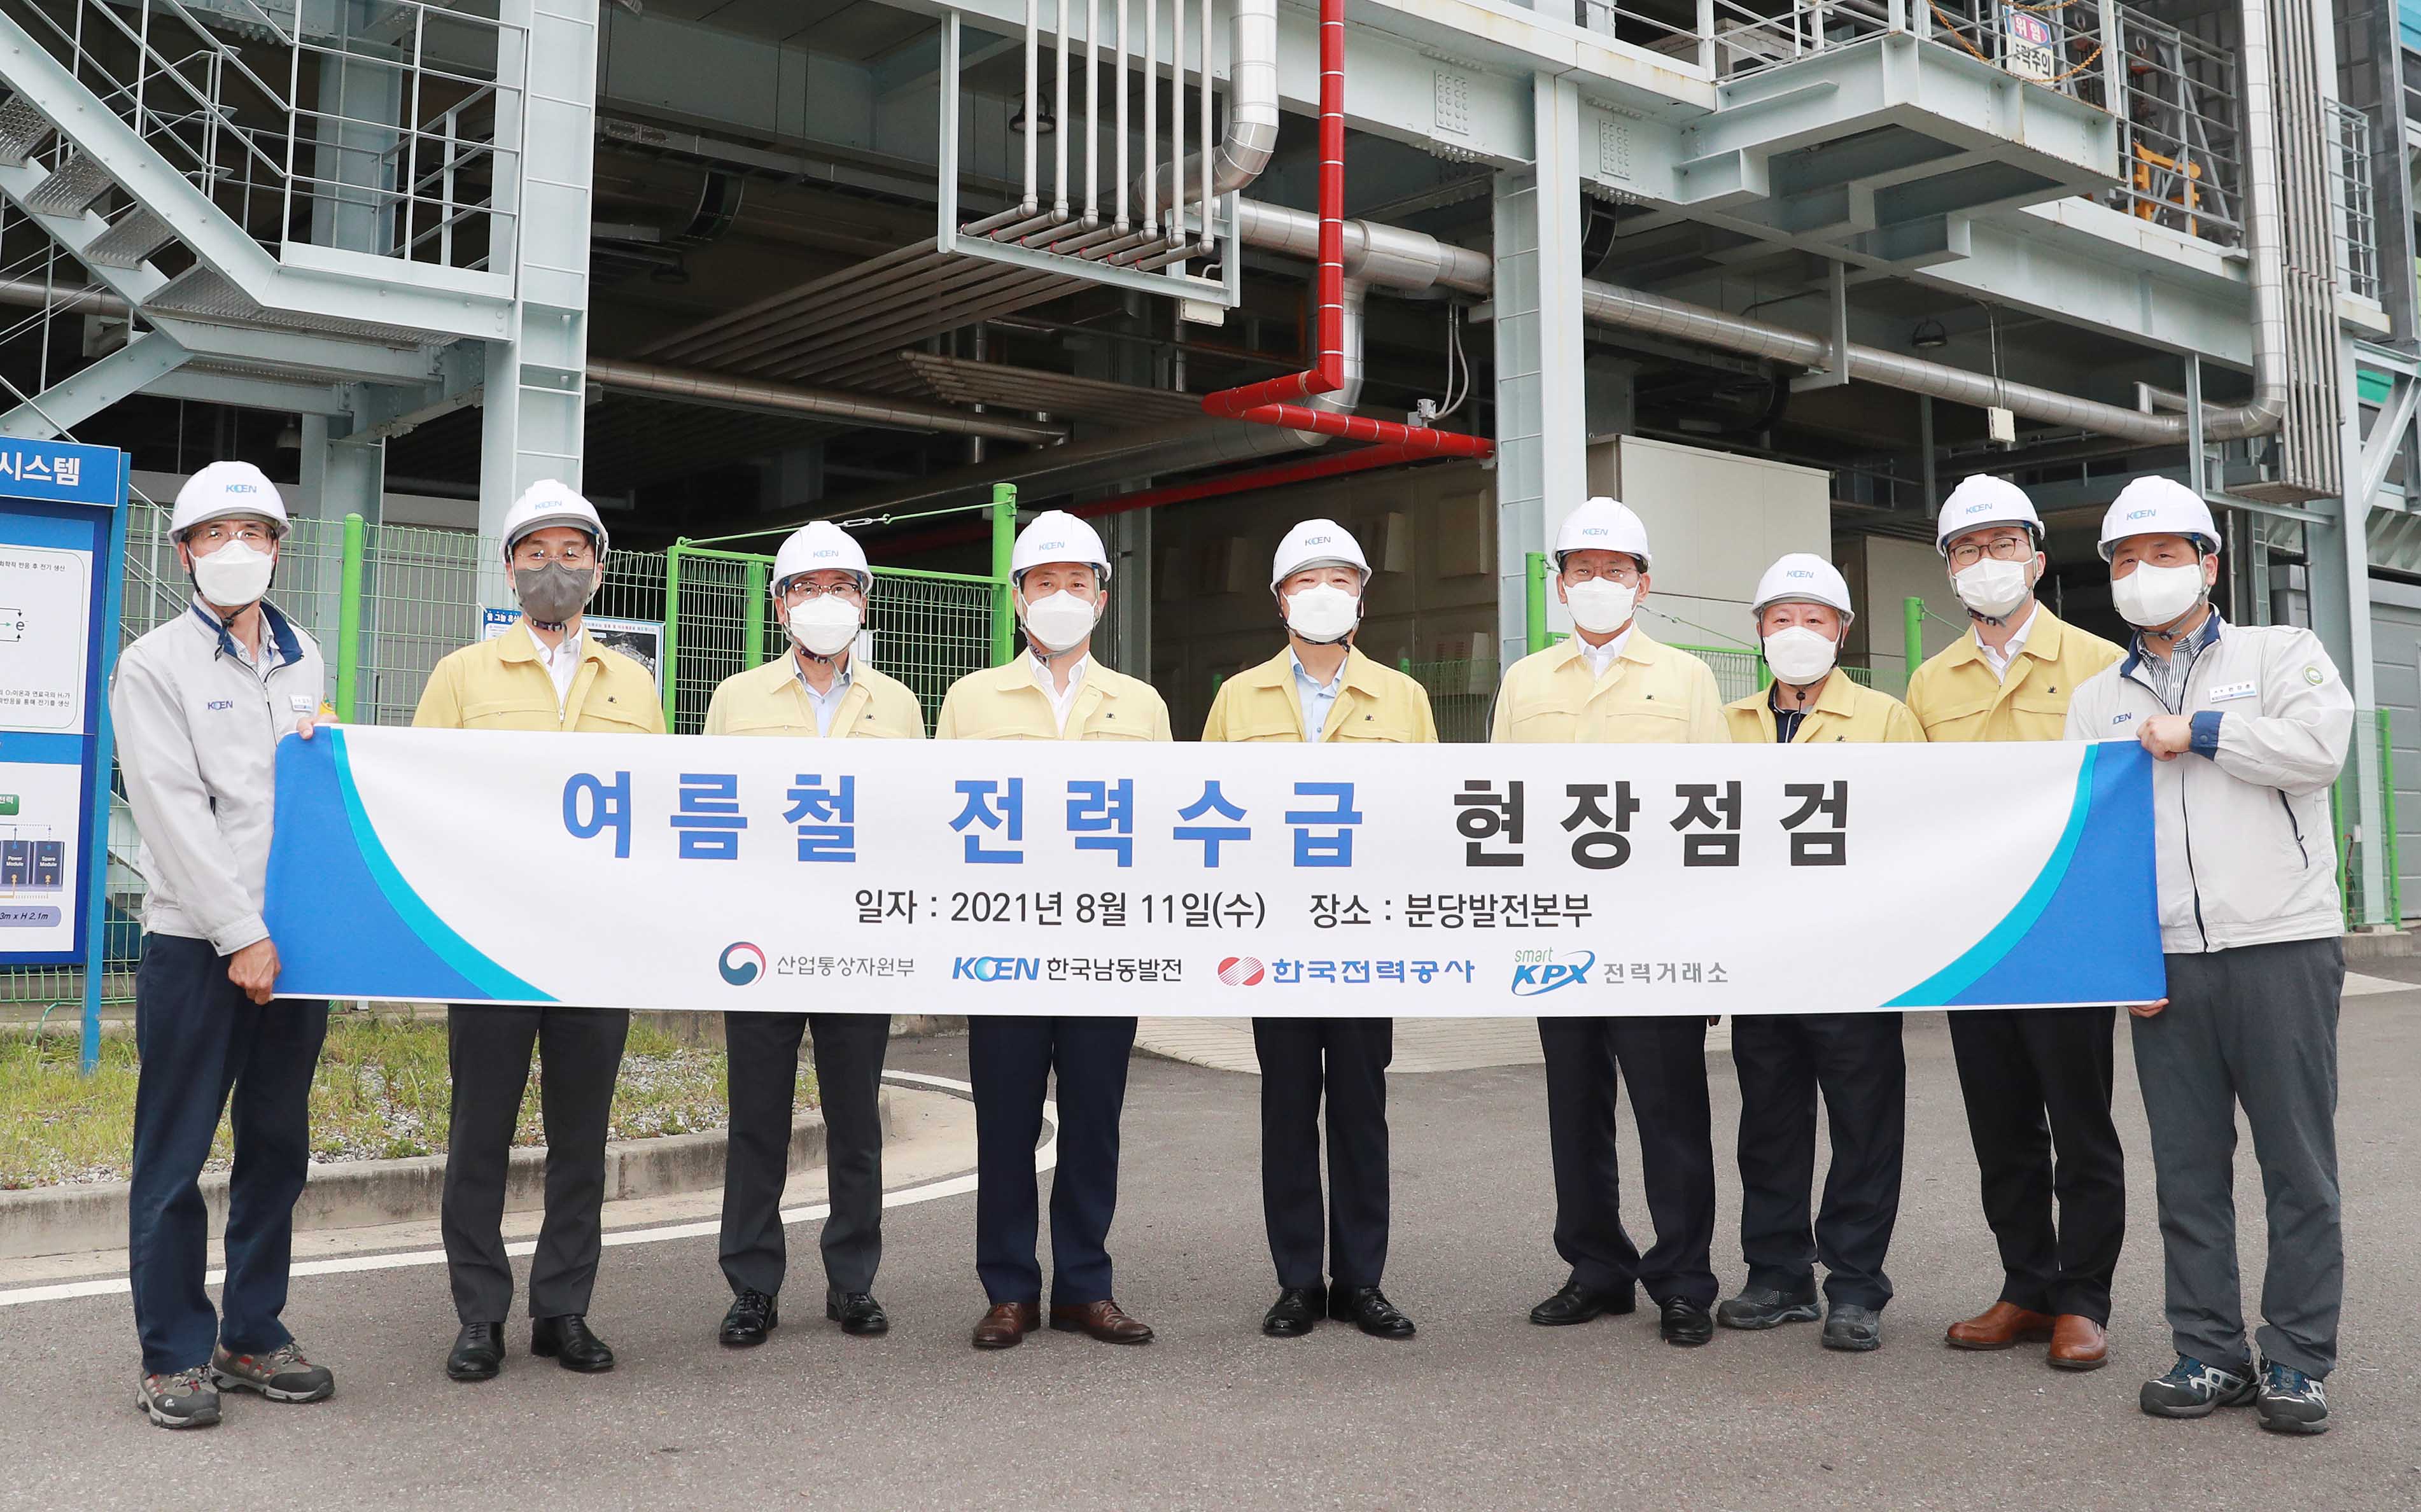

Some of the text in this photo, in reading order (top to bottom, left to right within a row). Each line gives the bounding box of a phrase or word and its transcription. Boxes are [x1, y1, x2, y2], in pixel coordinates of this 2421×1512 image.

[2015, 17, 2043, 43] 위험
[0, 452, 80, 486] 시스템
[225, 484, 257, 494] KOEN
[1965, 503, 1993, 514] KOEN
[2126, 509, 2156, 521] KOEN
[1305, 536, 1331, 546] KOEN
[1582, 528, 1609, 536] KOEN
[813, 550, 839, 559] KOEN
[1039, 541, 1065, 551] KOEN
[1786, 570, 1814, 578] KOEN
[207, 700, 234, 711] KOEN
[563, 771, 1848, 869] 여름철 전력수급 현장점검
[856, 890, 917, 924] 일자
[951, 892, 1062, 925] 2021년
[1077, 892, 1125, 926] 8월
[1142, 892, 1265, 928] 11일(수)
[1310, 894, 1371, 928] 장소
[1405, 894, 1592, 928] 분당발전본부
[1515, 946, 1554, 963] smart
[778, 956, 915, 977] 산업통상자원부
[953, 956, 1181, 982] KOEN 한국남동발전
[1272, 958, 1475, 983] 한국전력공사
[1512, 961, 1591, 991] KPX
[1603, 962, 1728, 984] 전력거래소
